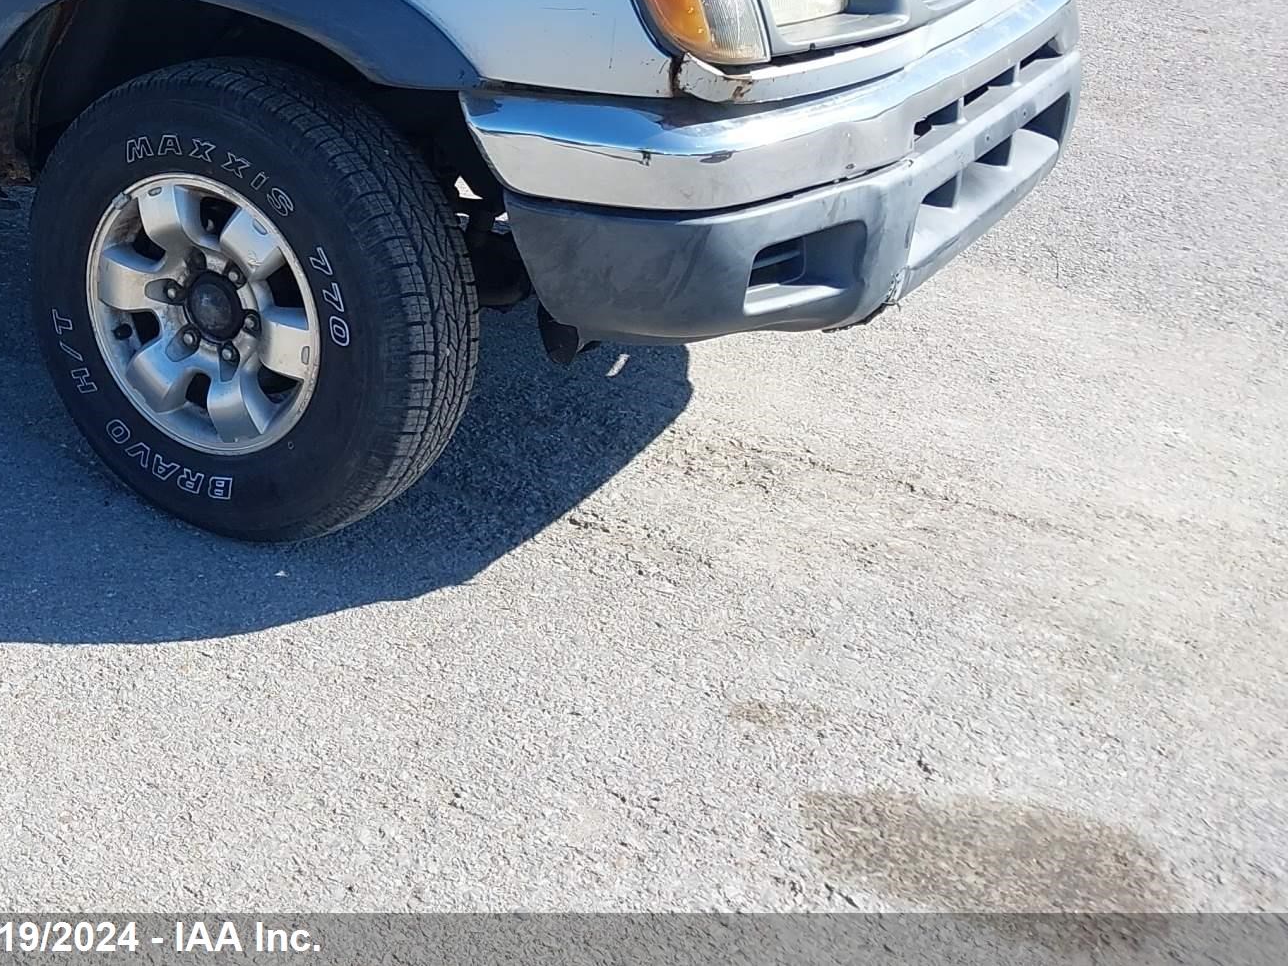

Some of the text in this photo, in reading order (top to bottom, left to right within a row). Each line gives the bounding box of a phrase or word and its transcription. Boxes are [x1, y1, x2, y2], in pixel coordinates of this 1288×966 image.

[126, 134, 350, 346] MAXXIS 770
[51, 308, 233, 500] BRAVO H/T
